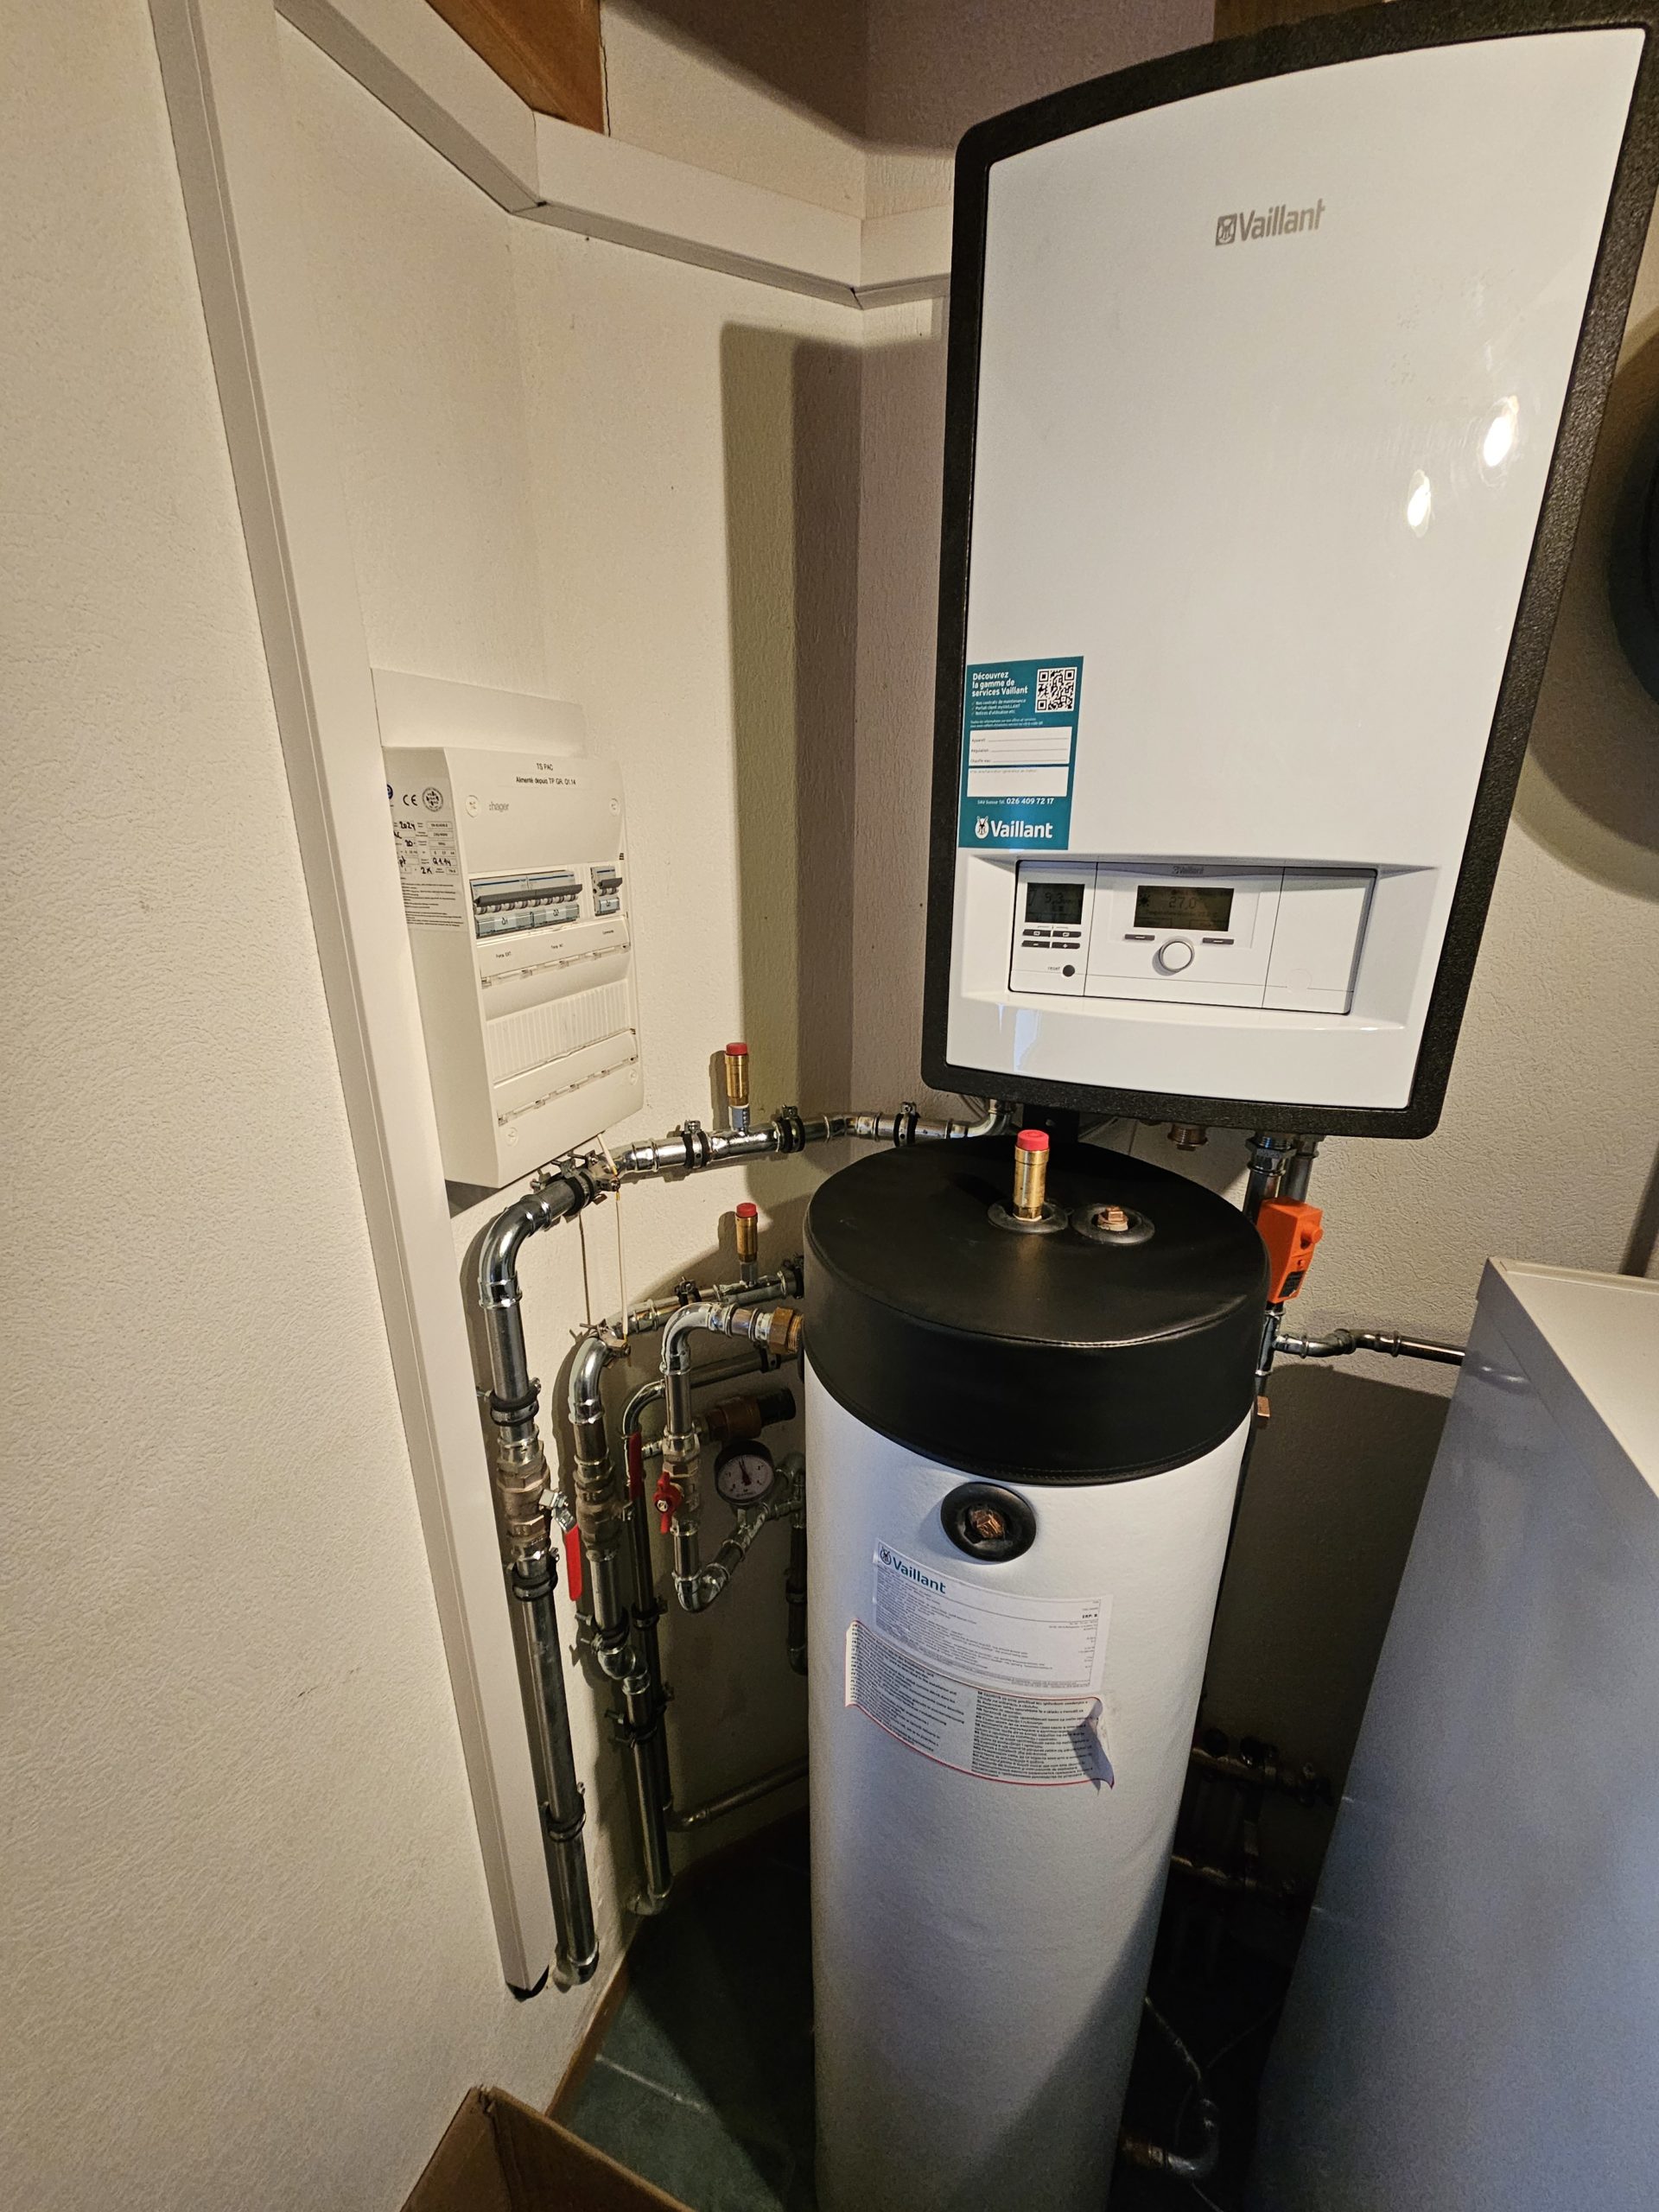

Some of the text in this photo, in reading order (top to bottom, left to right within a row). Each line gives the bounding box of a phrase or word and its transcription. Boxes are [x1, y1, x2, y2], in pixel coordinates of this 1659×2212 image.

[1239, 198, 1325, 242] Vaillant
[972, 671, 1009, 680] Découvrez
[972, 685, 1028, 697] services Vaillant
[980, 681, 1005, 690] gamme
[990, 820, 1053, 838] Vaillant
[893, 1557, 946, 1594] Vaillant
